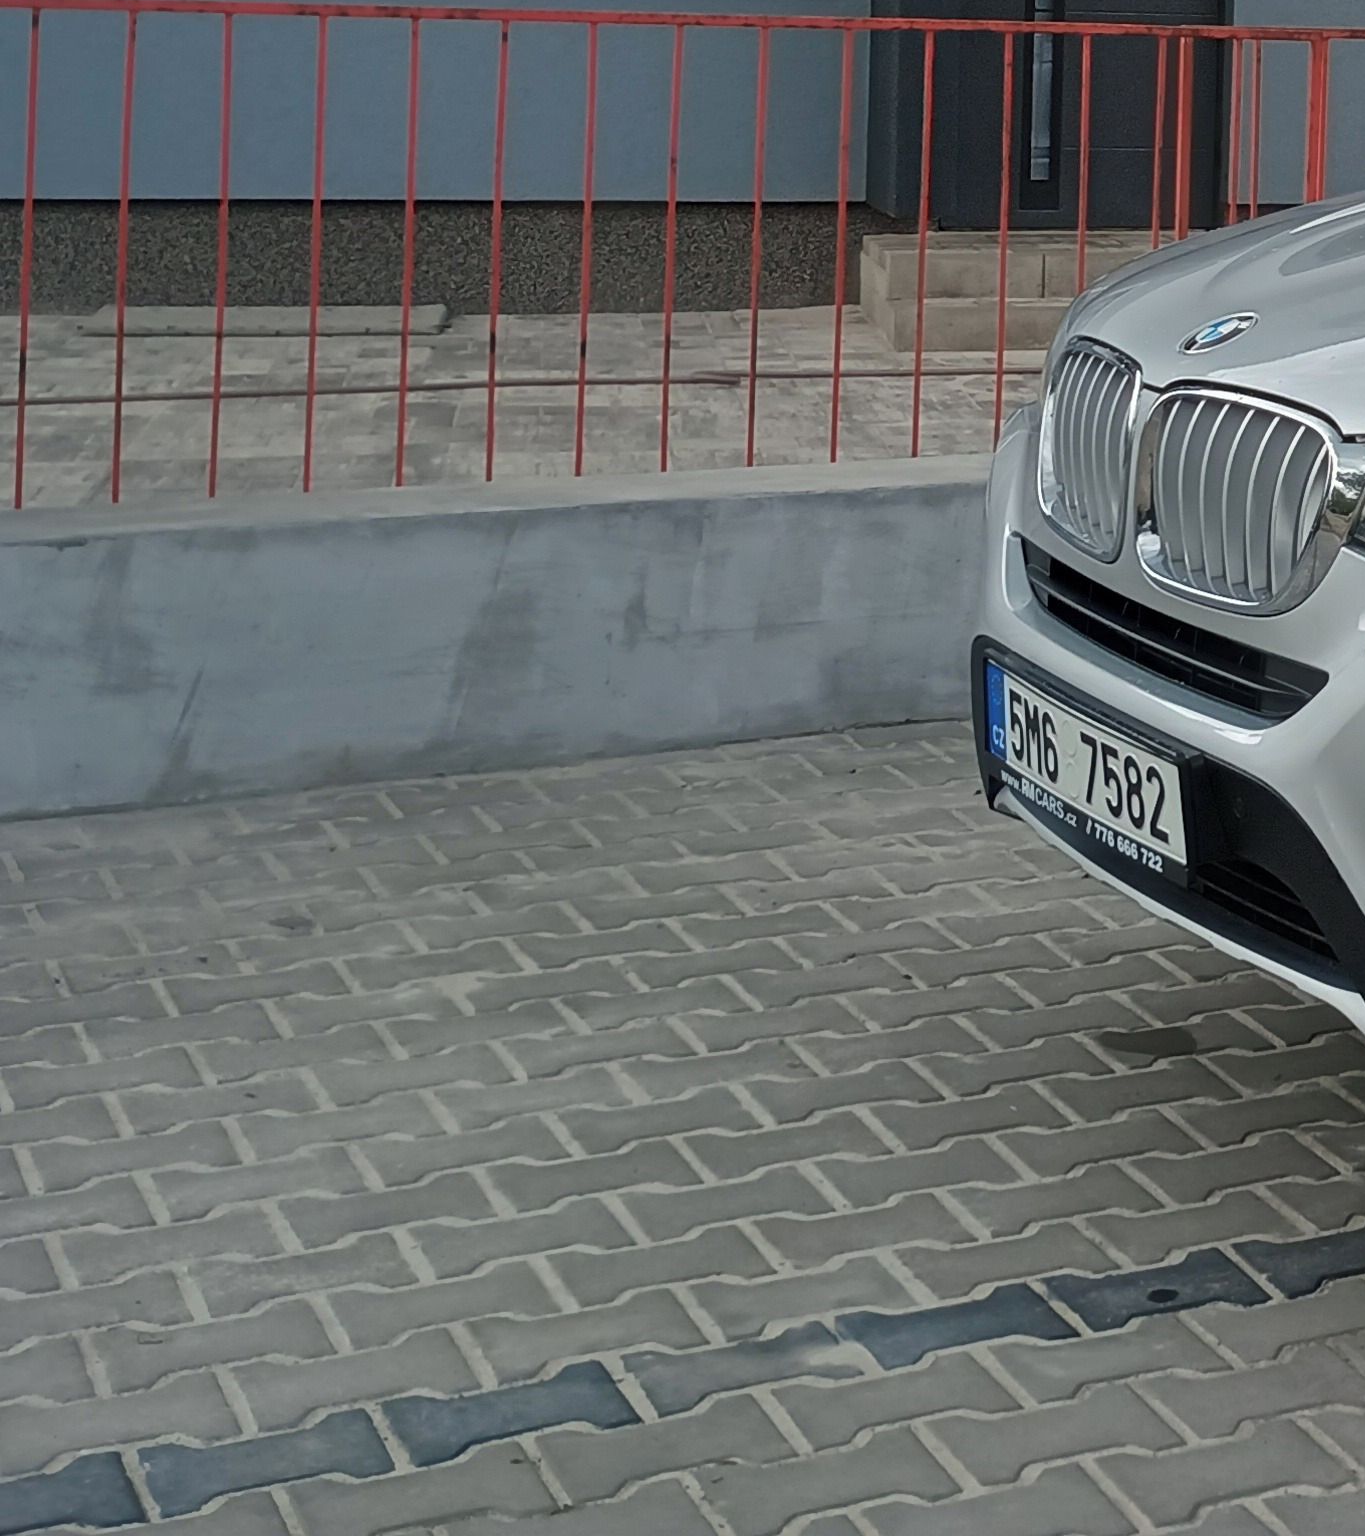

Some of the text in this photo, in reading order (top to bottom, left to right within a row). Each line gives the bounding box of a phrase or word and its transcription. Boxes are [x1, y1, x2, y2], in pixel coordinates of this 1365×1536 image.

[992, 724, 1005, 749] CZ
[1009, 688, 1170, 844] 5M6 7582
[1140, 847, 1164, 873] 722
